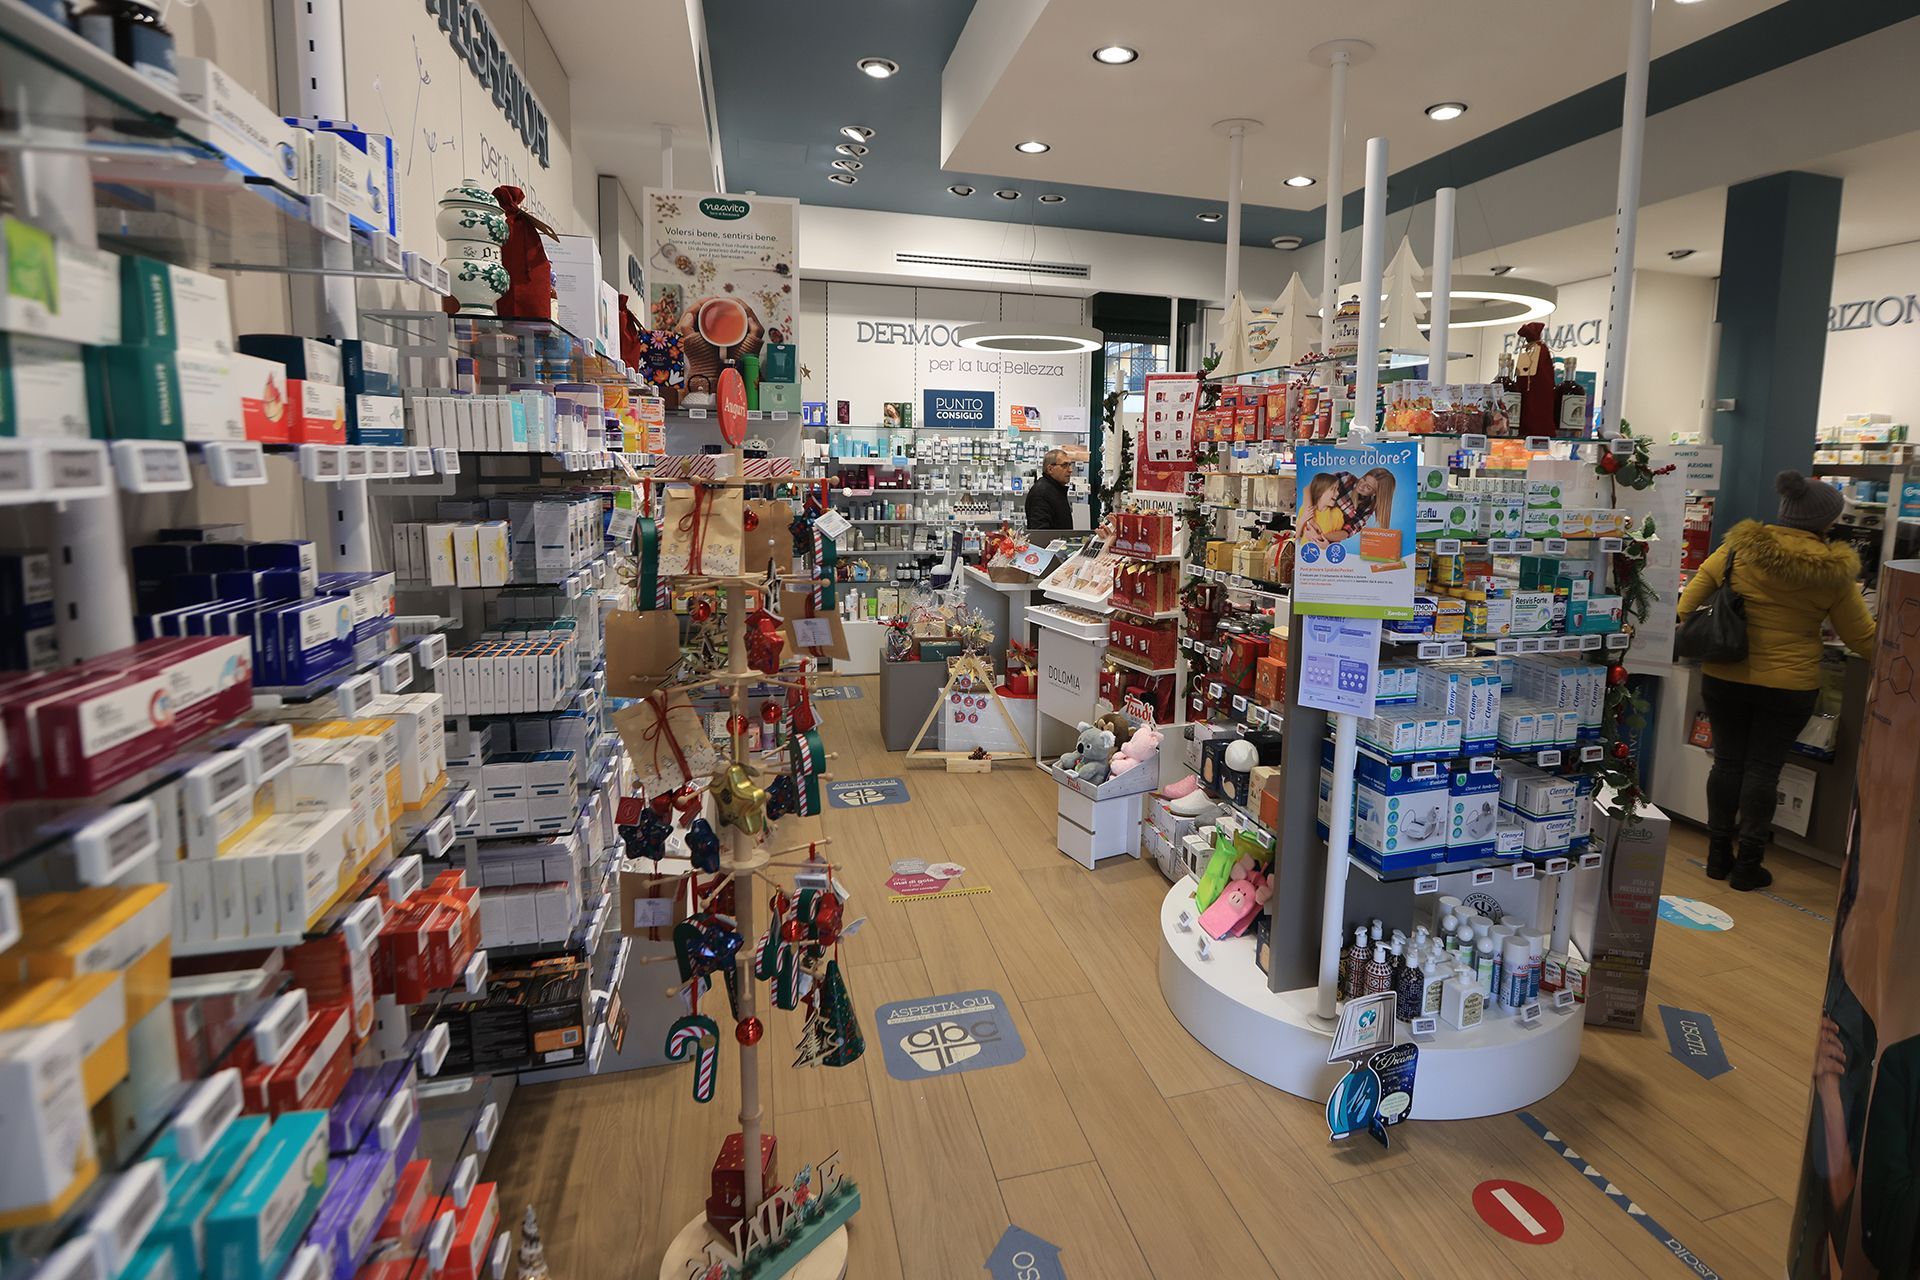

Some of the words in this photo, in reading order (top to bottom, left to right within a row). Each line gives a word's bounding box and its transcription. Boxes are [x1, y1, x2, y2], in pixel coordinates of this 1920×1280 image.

[704, 203, 745, 213] neavita
[665, 227, 695, 236] Volersi
[696, 229, 720, 239] bene,
[722, 232, 754, 240] sentirsi
[755, 233, 778, 242] bene.
[1503, 319, 1602, 354] FAMACI
[929, 358, 955, 373] per
[958, 358, 972, 373] la
[976, 360, 999, 374] tua
[1004, 361, 1064, 377] Bellezza
[724, 398, 746, 419] Auguri
[936, 398, 983, 411] PUNTO
[936, 411, 983, 420] CONSIGLIO
[1304, 452, 1346, 467] Febbre
[1349, 456, 1357, 465] e
[1359, 449, 1412, 465] dolore?
[1416, 508, 1437, 518] uraflu
[1534, 596, 1548, 604] Forte
[1048, 665, 1081, 690] DOLOMIA
[1484, 689, 1494, 719] Clenny
[1559, 680, 1568, 708] Clenny
[1573, 679, 1582, 708] Clenny
[1591, 679, 1600, 708] Clenny
[1125, 696, 1152, 721] Trudi
[1469, 690, 1478, 720] Clenny
[1549, 787, 1567, 796] Clenny
[889, 1001, 959, 1019] ASPETTA
[962, 996, 992, 1008] QUI
[1680, 1020, 1707, 1056] USCITA
